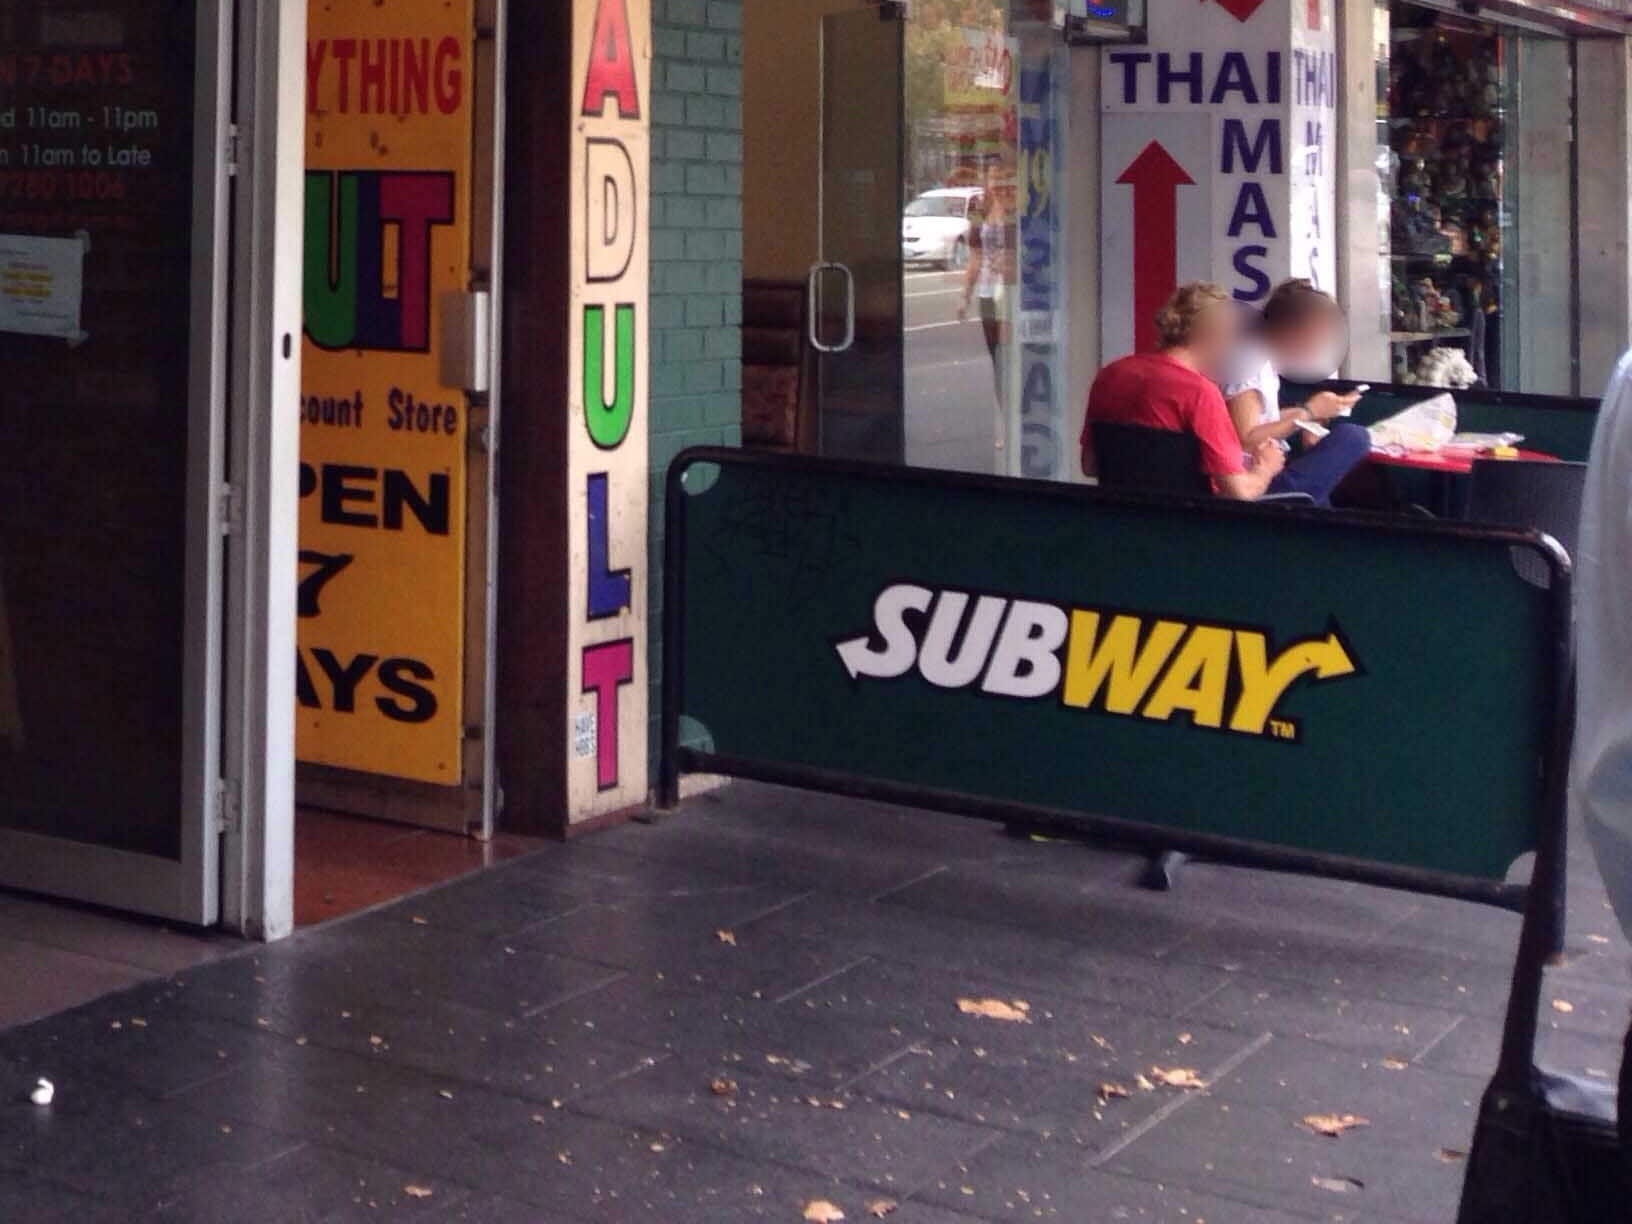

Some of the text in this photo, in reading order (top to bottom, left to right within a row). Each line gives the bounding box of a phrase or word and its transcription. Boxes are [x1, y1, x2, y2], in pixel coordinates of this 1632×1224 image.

[1108, 50, 1282, 105] THAI
[27, 106, 81, 129] 11am
[104, 106, 159, 133] 11pm
[21, 144, 75, 166] 11am
[81, 144, 101, 165] to
[107, 145, 152, 166] Late
[387, 384, 458, 436] Store
[835, 583, 1356, 736] SUBWAY
